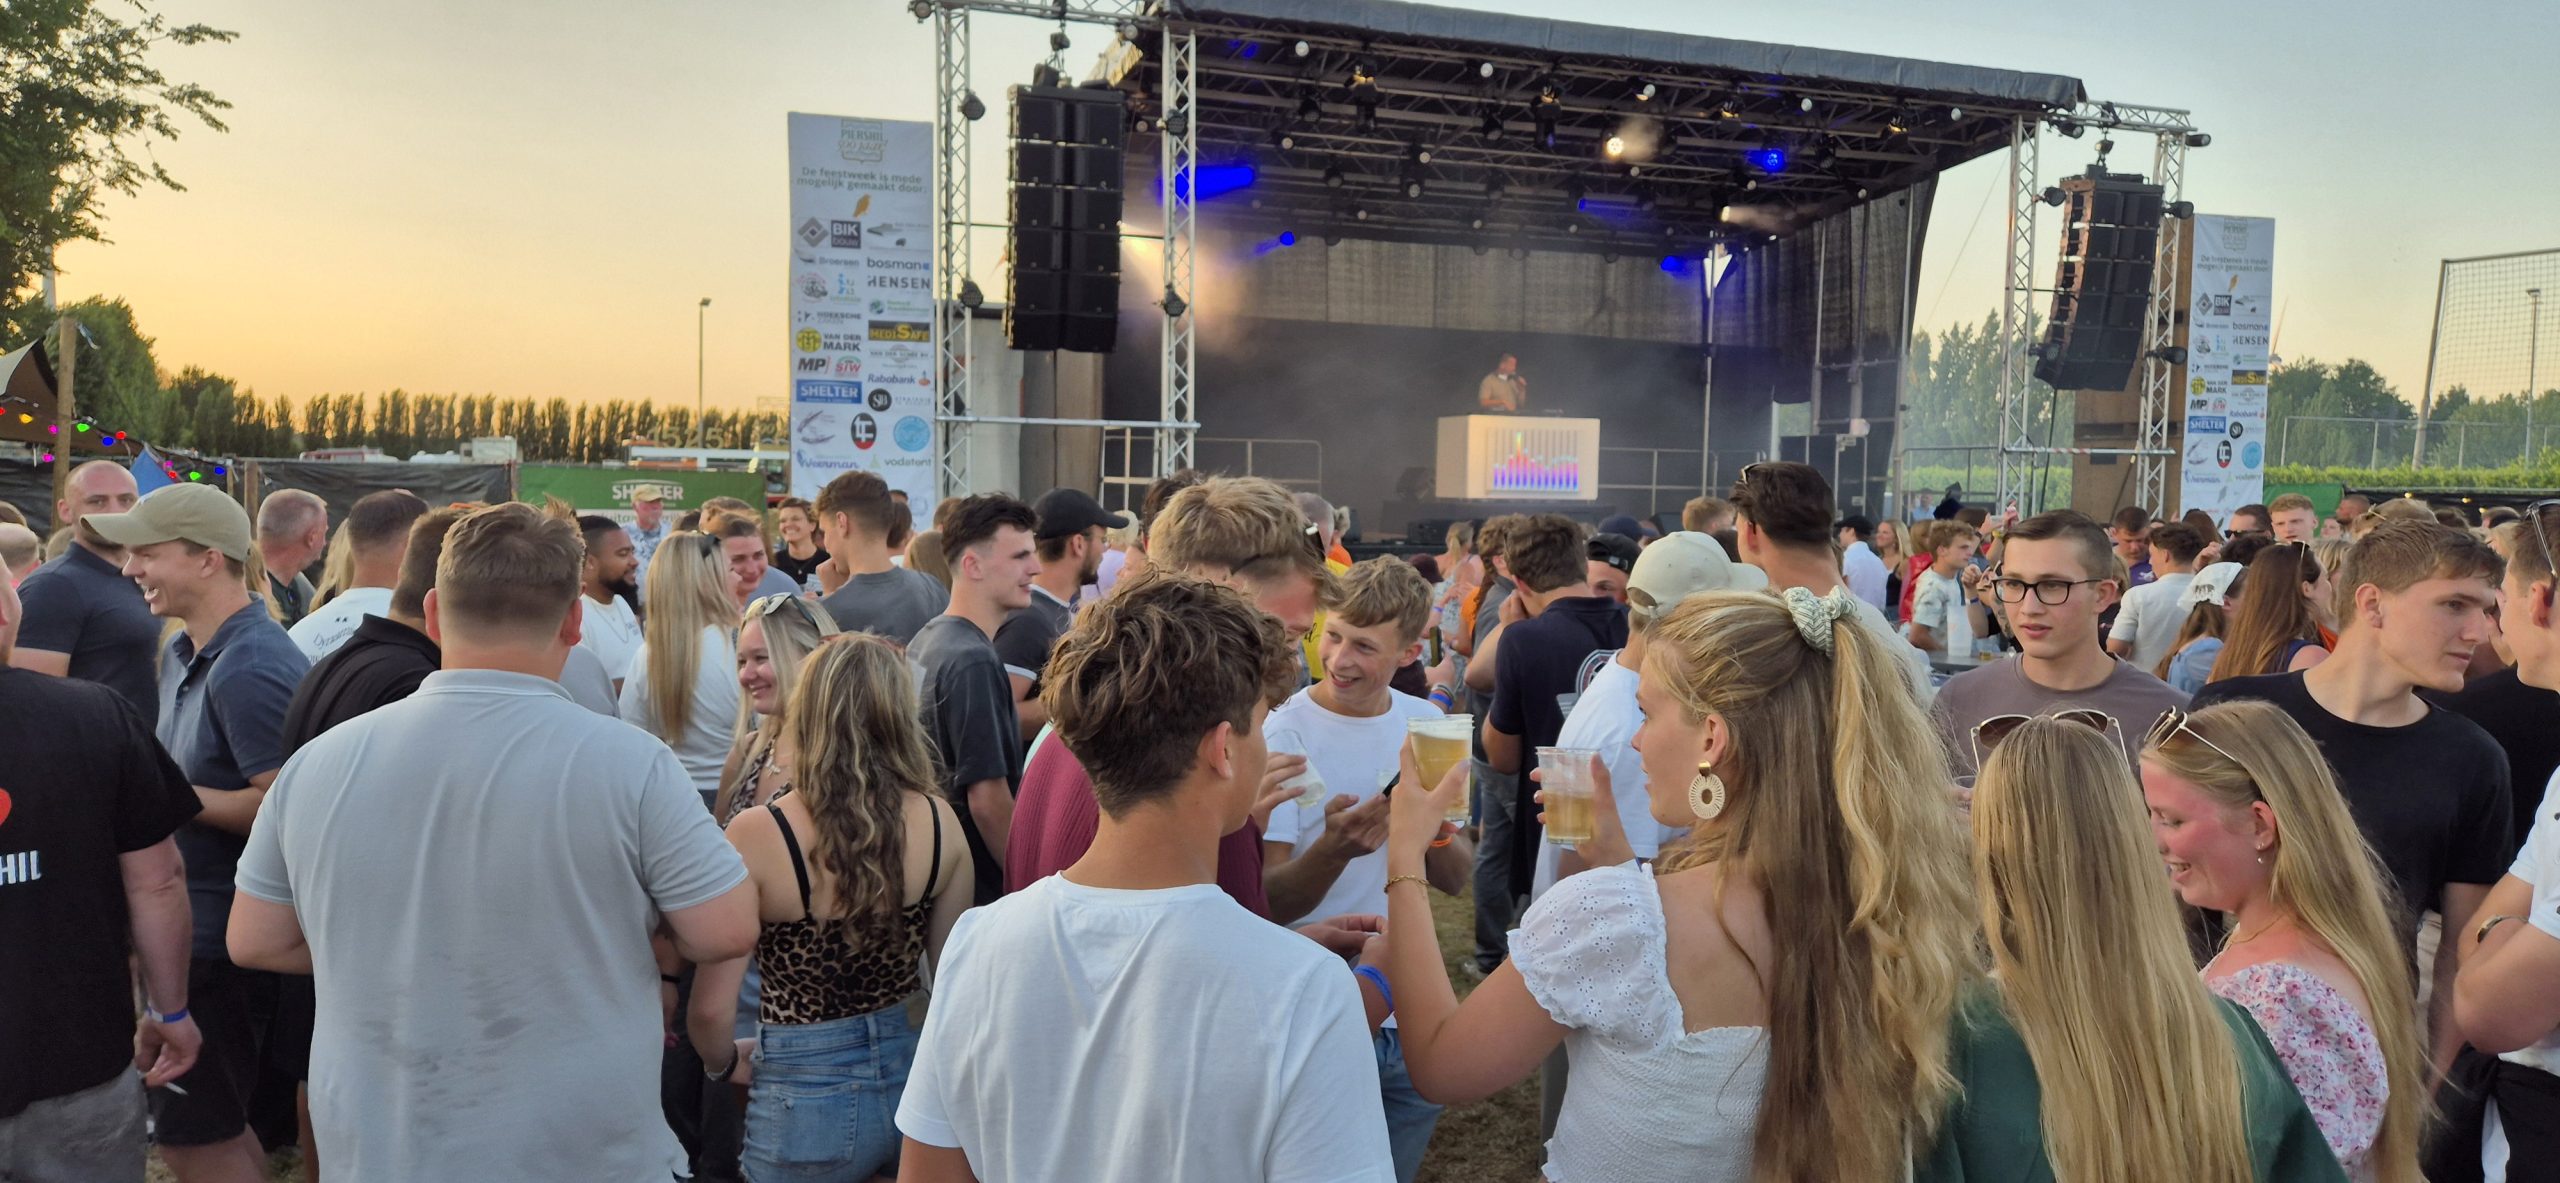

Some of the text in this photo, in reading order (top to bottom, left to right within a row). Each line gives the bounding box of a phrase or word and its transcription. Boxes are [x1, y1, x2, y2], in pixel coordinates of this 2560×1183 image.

[802, 167, 922, 184] De feestweek is mede
[797, 177, 842, 190] mogelijk
[847, 180, 896, 191] gemaakt
[832, 223, 858, 236] BIK
[867, 257, 921, 271] bosman
[867, 276, 930, 289] HENSEN
[823, 341, 860, 352] MARK
[798, 358, 826, 371] MP
[868, 373, 916, 384] Rabobank
[801, 385, 858, 397] SHELTER
